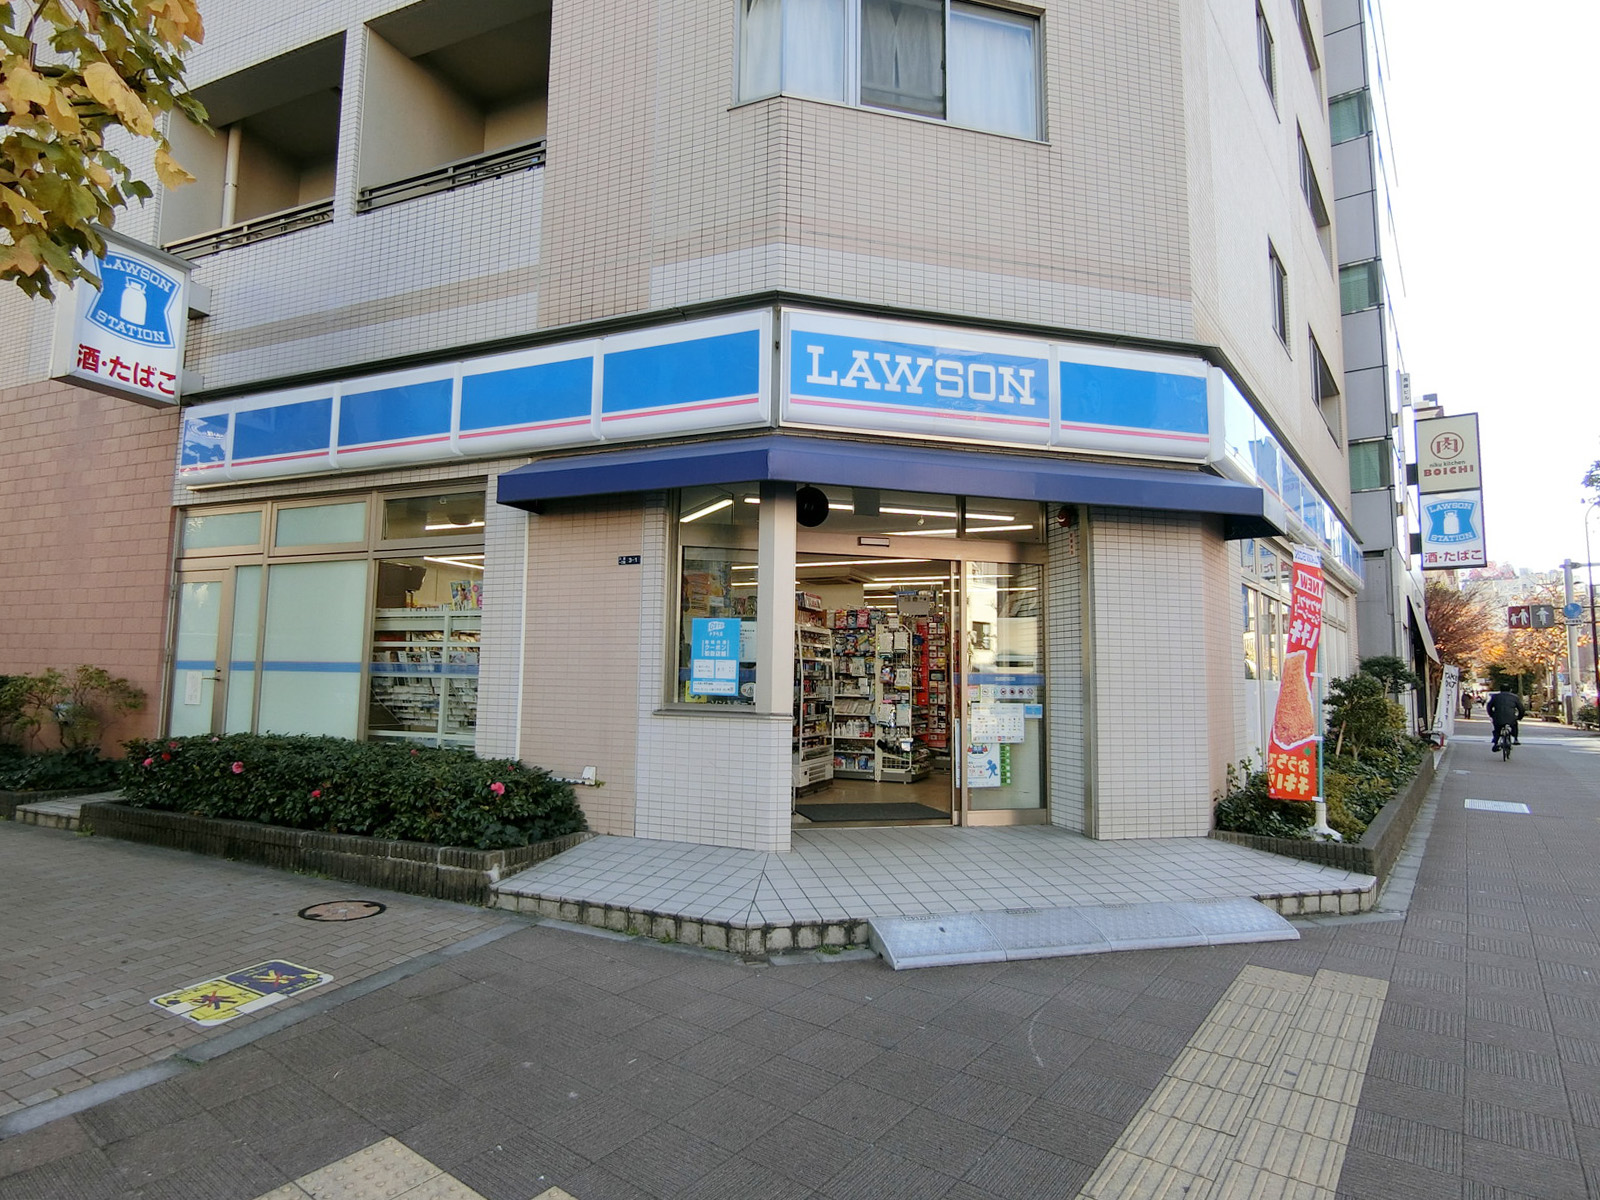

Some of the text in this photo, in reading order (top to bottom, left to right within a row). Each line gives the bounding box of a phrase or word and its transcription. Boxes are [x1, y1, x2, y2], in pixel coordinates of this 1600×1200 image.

[102, 259, 172, 293] LAWSON
[95, 309, 166, 343] STATION
[807, 345, 1036, 406] LAWSON
[1423, 464, 1474, 477] BOICHI
[1429, 502, 1473, 513] LAWSON
[1430, 532, 1474, 543] STATION
